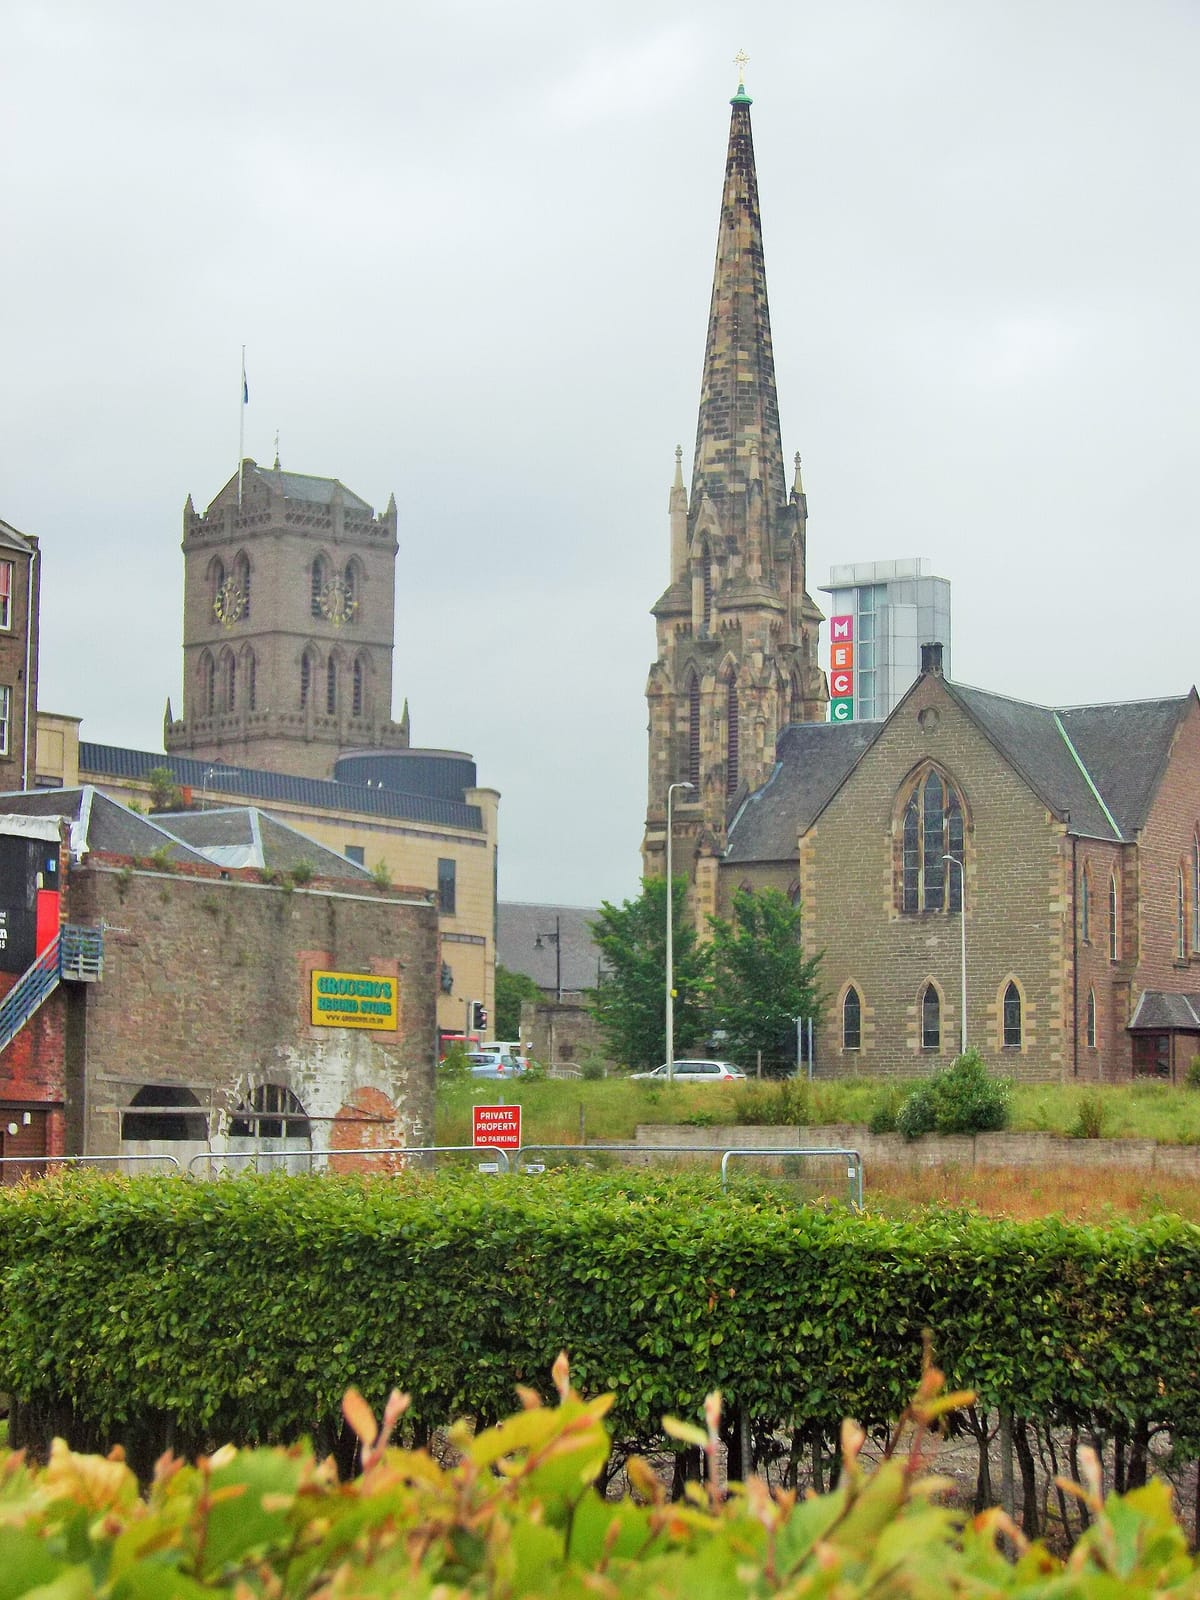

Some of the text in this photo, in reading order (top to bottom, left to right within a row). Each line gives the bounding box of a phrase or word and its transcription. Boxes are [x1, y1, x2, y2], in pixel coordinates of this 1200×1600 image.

[317, 996, 392, 1016] RECORD STORE
[480, 1111, 513, 1120] PRIVATE
[476, 1122, 517, 1131] PROPERTY
[476, 1135, 518, 1143] NO PARKING
